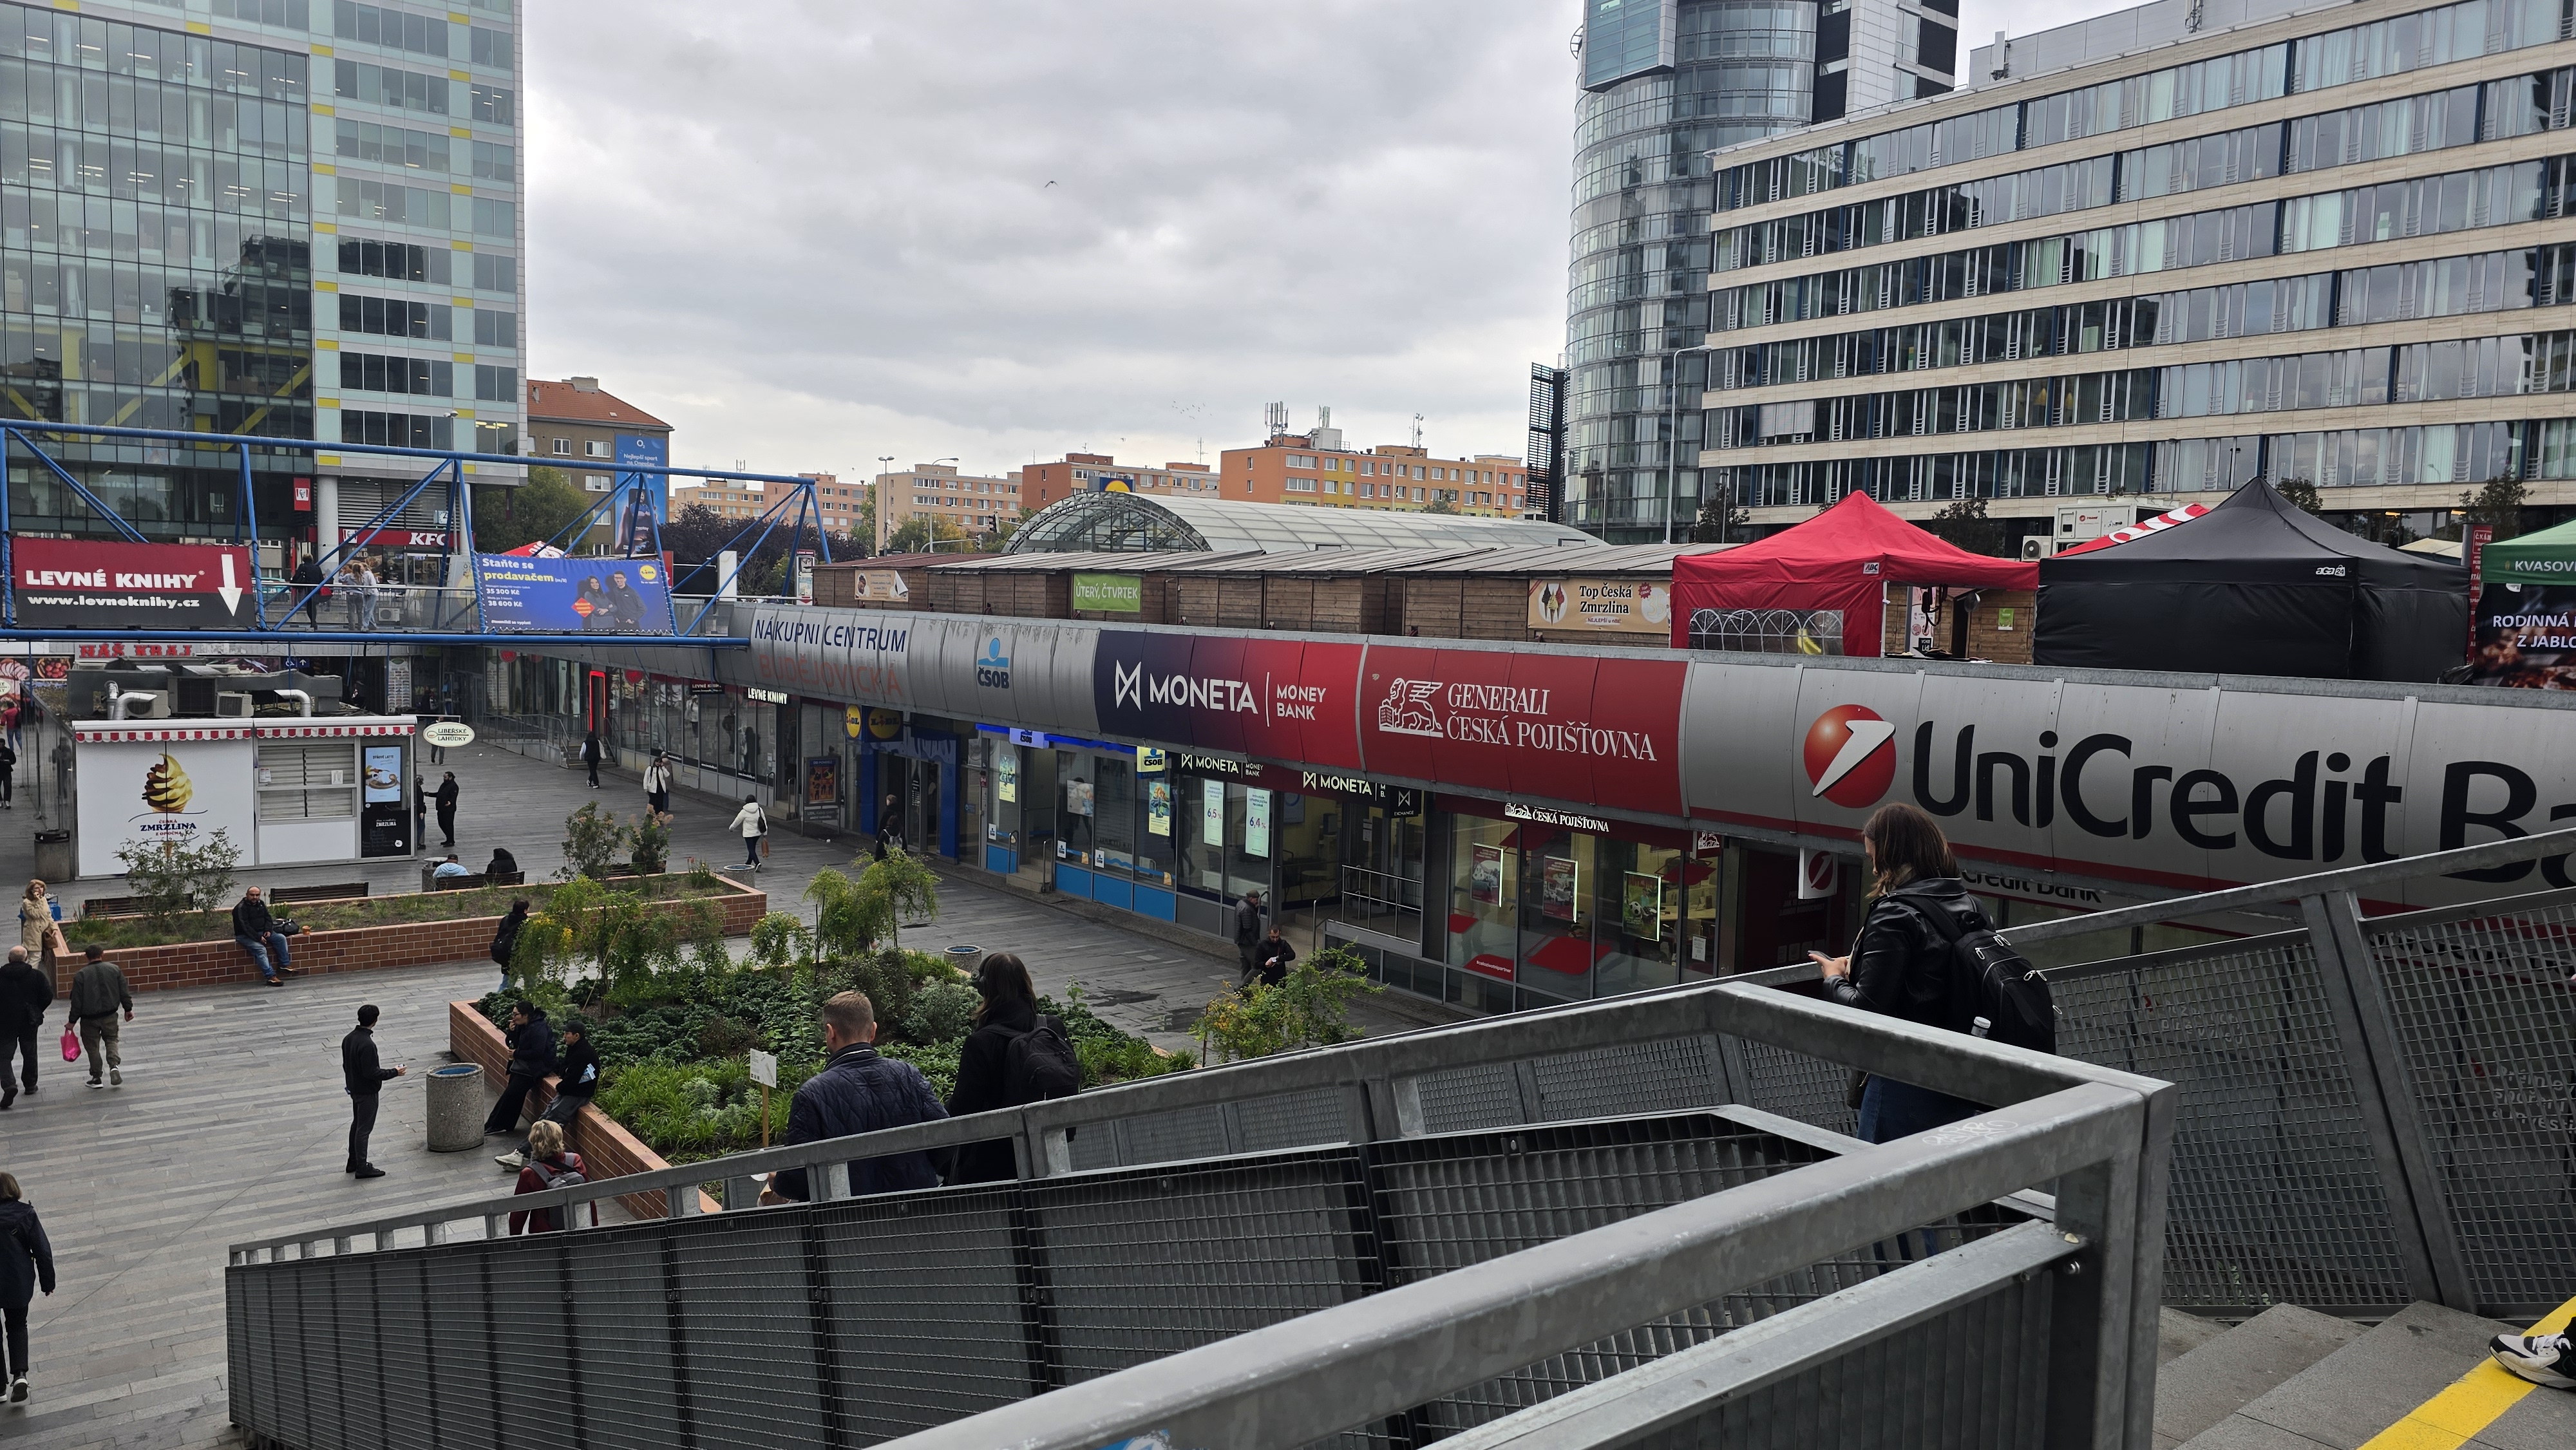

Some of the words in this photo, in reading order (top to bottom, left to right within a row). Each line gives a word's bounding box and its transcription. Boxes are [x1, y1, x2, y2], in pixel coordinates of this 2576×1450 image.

[408, 532, 446, 546] KFC
[482, 558, 520, 569] Staňte
[26, 569, 107, 587] LEVNÉ
[115, 573, 197, 589] KNIHY
[484, 571, 554, 582] prodavačem
[1075, 581, 1101, 599] ÚTERÝ,
[1101, 582, 1138, 599] ČTVRTEK
[1579, 585, 1599, 600] Top
[1601, 581, 1632, 599] Česká
[27, 595, 200, 610] www.levneknihy.cz
[1580, 601, 1629, 614] Zmrzlina
[2492, 612, 2570, 628] RODINNÁ
[824, 625, 907, 652] CENTRUM
[2517, 635, 2526, 647] Z
[79, 642, 126, 659] NÁŠ
[134, 644, 193, 657] KRAJ
[758, 653, 903, 697] BUDĚJOVICKÁ
[977, 666, 1010, 689] ČSOB
[767, 690, 788, 704] KNIHY
[1150, 672, 1258, 715] MONETA
[1276, 683, 1327, 703] MONEY
[1447, 683, 1551, 715] GENERALI
[1276, 702, 1316, 721] BANK
[1446, 710, 1511, 746] ČESKÁ
[1516, 720, 1658, 762] POJIŠŤOVNA
[1195, 755, 1239, 774] MONETA
[1245, 762, 1264, 771] MONEY
[1245, 769, 1260, 777] BANK
[1320, 774, 1372, 796] MONETA
[1912, 720, 2402, 865] UniCredit
[1207, 807, 1217, 820] 6,5
[1249, 816, 1260, 829] 6,4
[1532, 809, 1558, 825] ČESKÁ
[1559, 815, 1609, 833] POJIŠŤOVNA
[140, 822, 197, 831] ZMRZLINA
